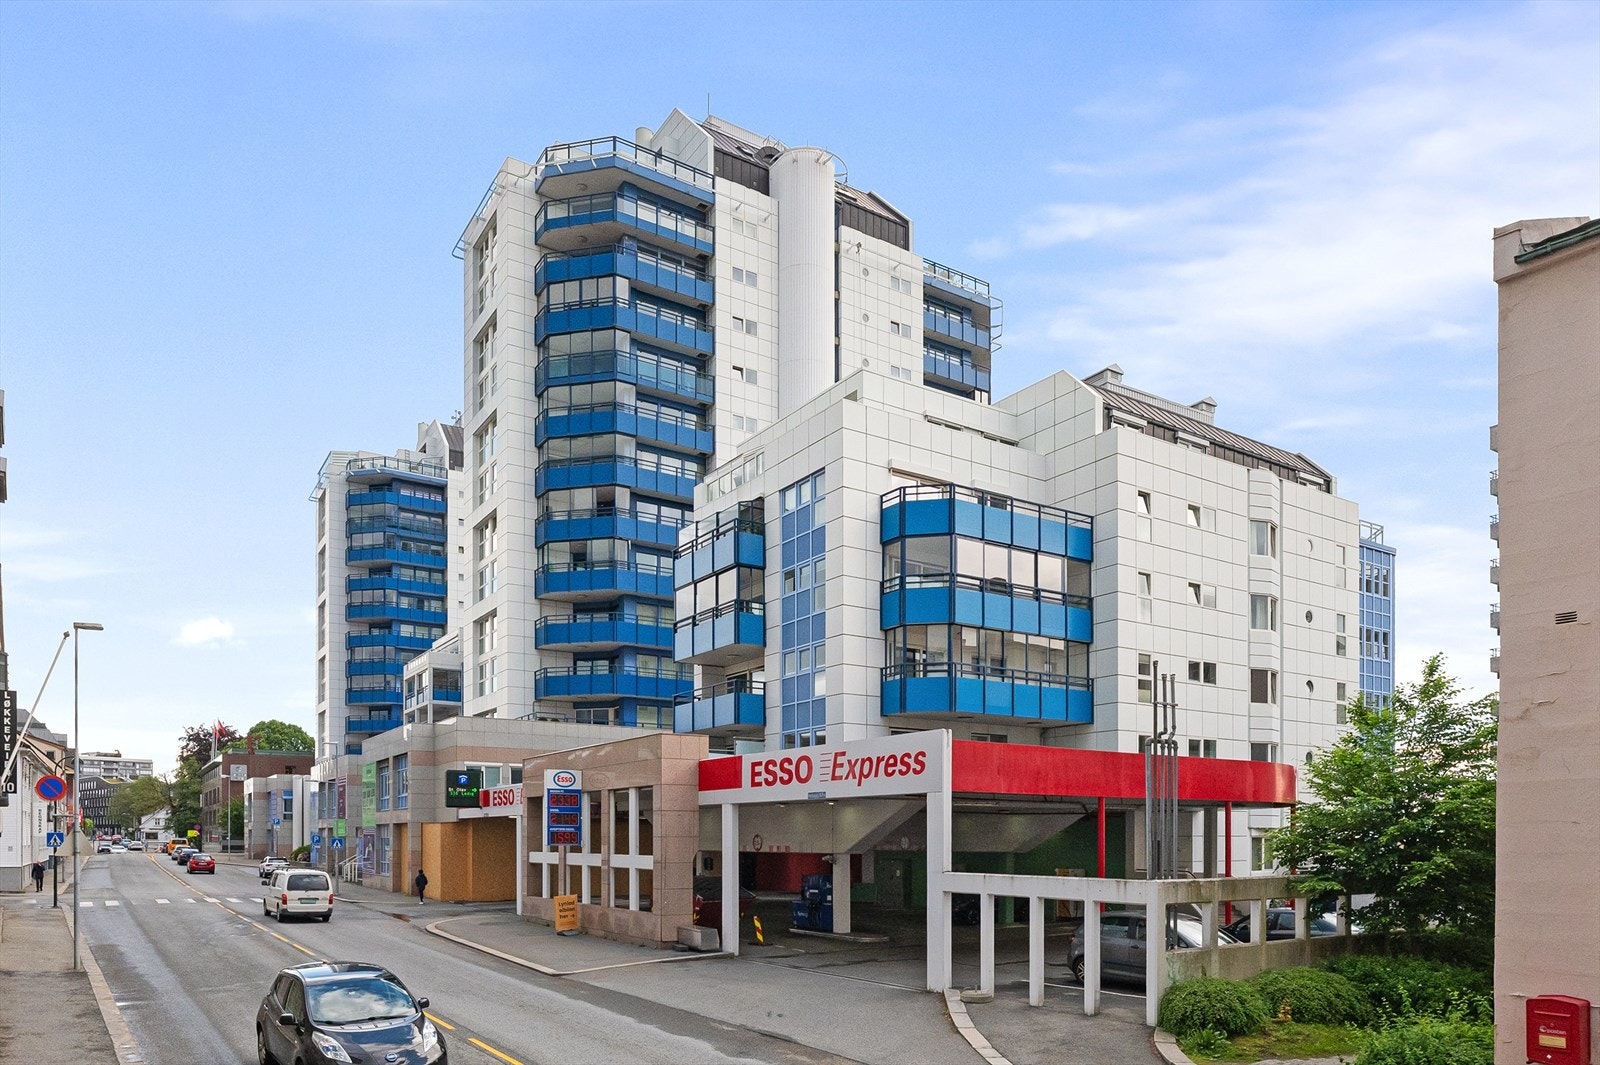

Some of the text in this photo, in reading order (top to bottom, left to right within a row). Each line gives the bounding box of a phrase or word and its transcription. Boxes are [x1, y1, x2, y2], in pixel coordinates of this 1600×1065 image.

[750, 750, 927, 788] ESSO Express
[556, 775, 573, 783] Esso
[493, 789, 515, 806] ESSO
